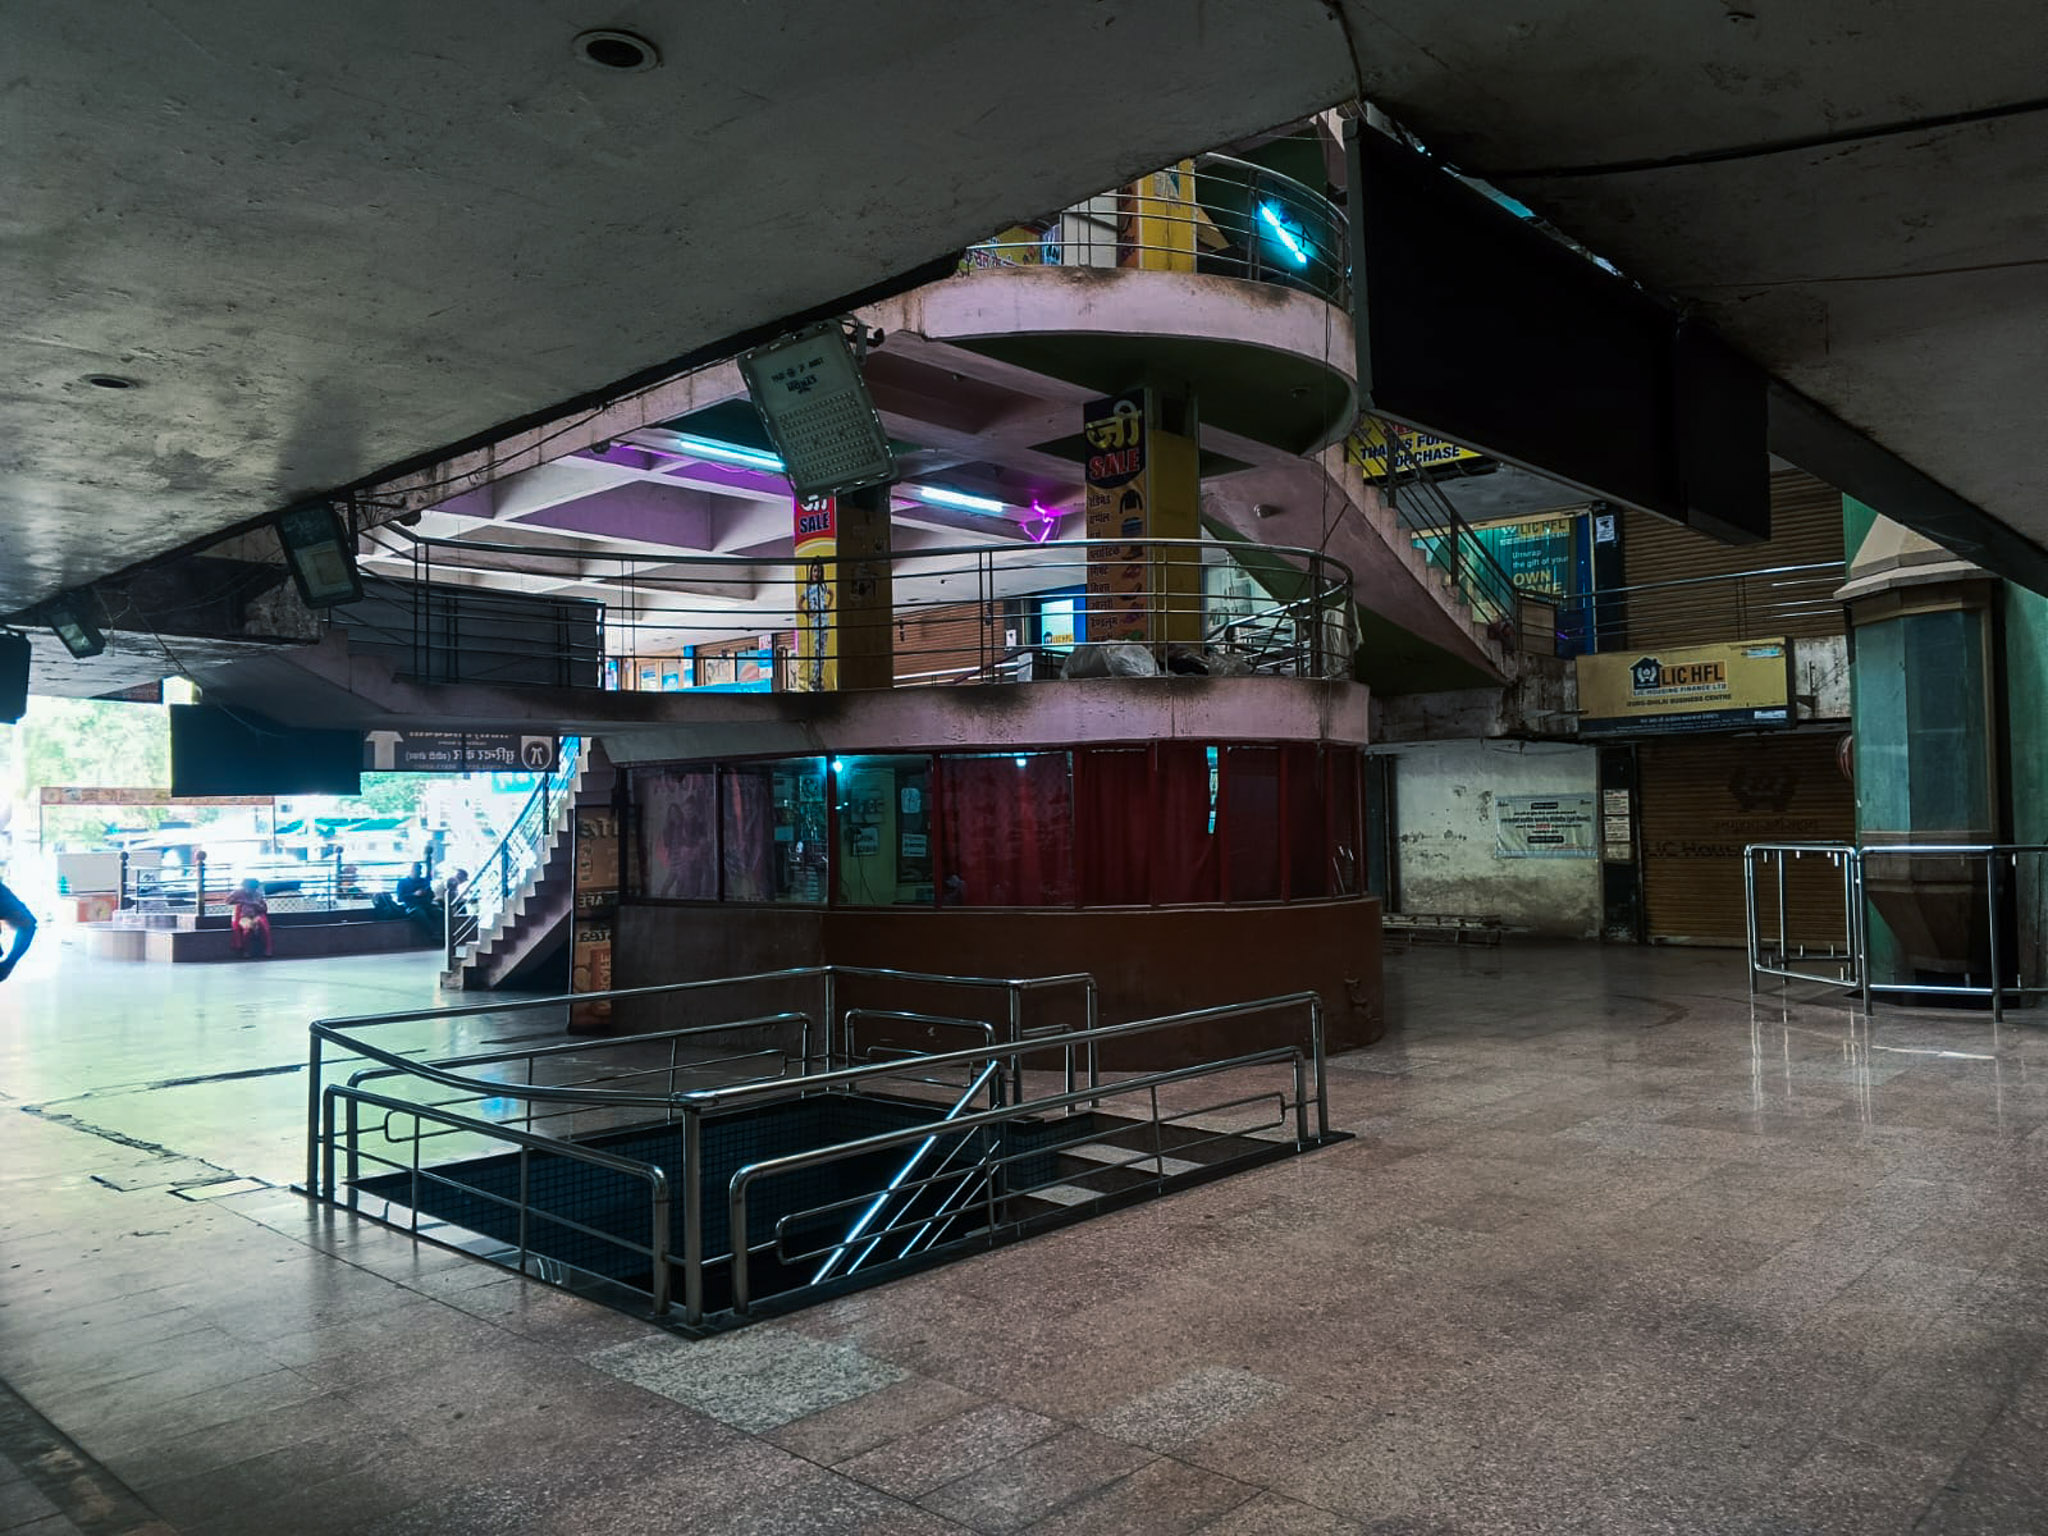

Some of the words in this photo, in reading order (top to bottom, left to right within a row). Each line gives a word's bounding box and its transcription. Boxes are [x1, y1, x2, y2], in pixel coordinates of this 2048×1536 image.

[1361, 438, 1413, 460] THAKS
[1394, 445, 1460, 467] URCHASE
[1089, 451, 1140, 480] SALE
[800, 512, 829, 534] SALE
[1512, 549, 1542, 560] Unwrap
[1513, 560, 1525, 569] the
[1526, 559, 1540, 569] gift
[1540, 558, 1550, 566] of
[1551, 556, 1568, 566] your
[1513, 569, 1551, 586] OWN
[1517, 582, 1563, 595] OME
[1660, 668, 1687, 686] LIC
[1691, 664, 1724, 683] HFL
[1680, 684, 1710, 692] FINANCE
